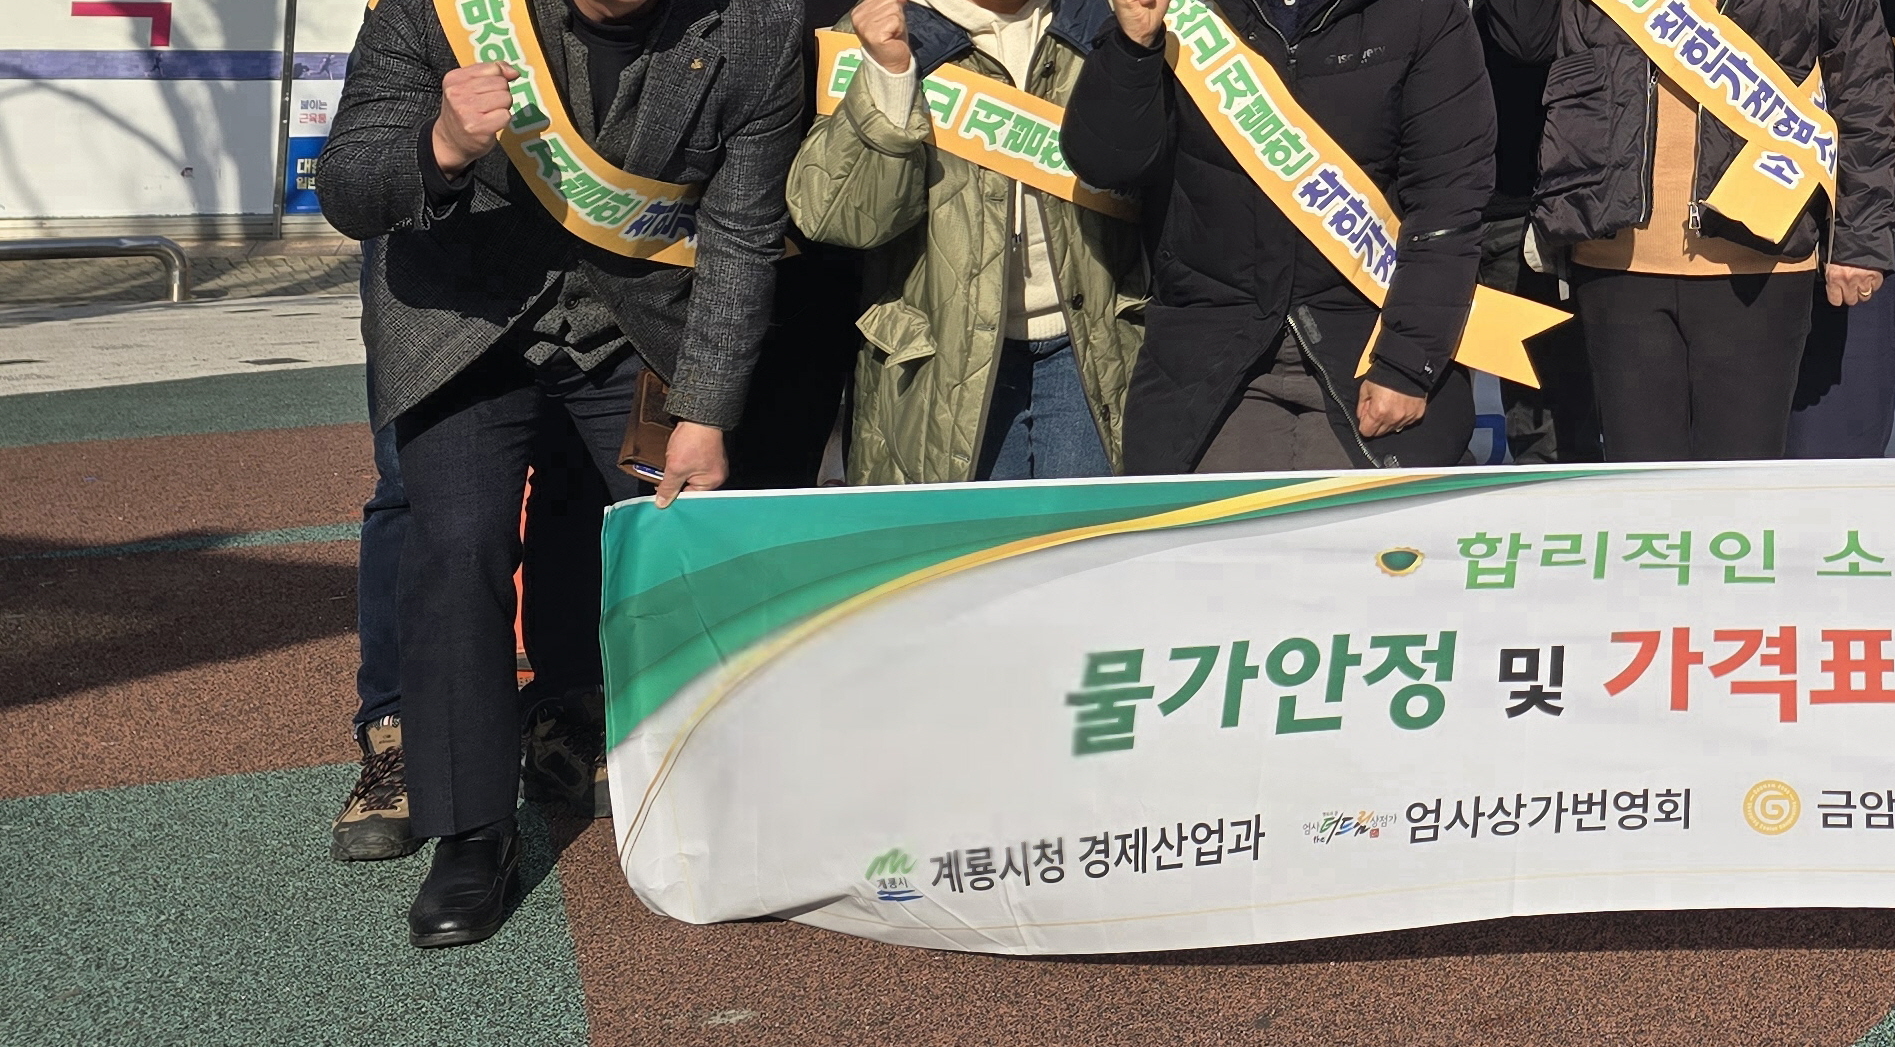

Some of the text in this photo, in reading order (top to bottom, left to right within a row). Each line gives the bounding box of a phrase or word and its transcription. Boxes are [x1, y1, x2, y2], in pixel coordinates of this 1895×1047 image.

[1210, 59, 1313, 176] 저렴한
[1456, 529, 1777, 590] 합리적인
[1065, 630, 1457, 755] 물가안정
[1499, 645, 1564, 717] 및
[1405, 786, 1693, 845] 엄사상가번영회
[877, 877, 908, 889] 계룡시
[930, 814, 1265, 893] 계룡시청 경제산업과
